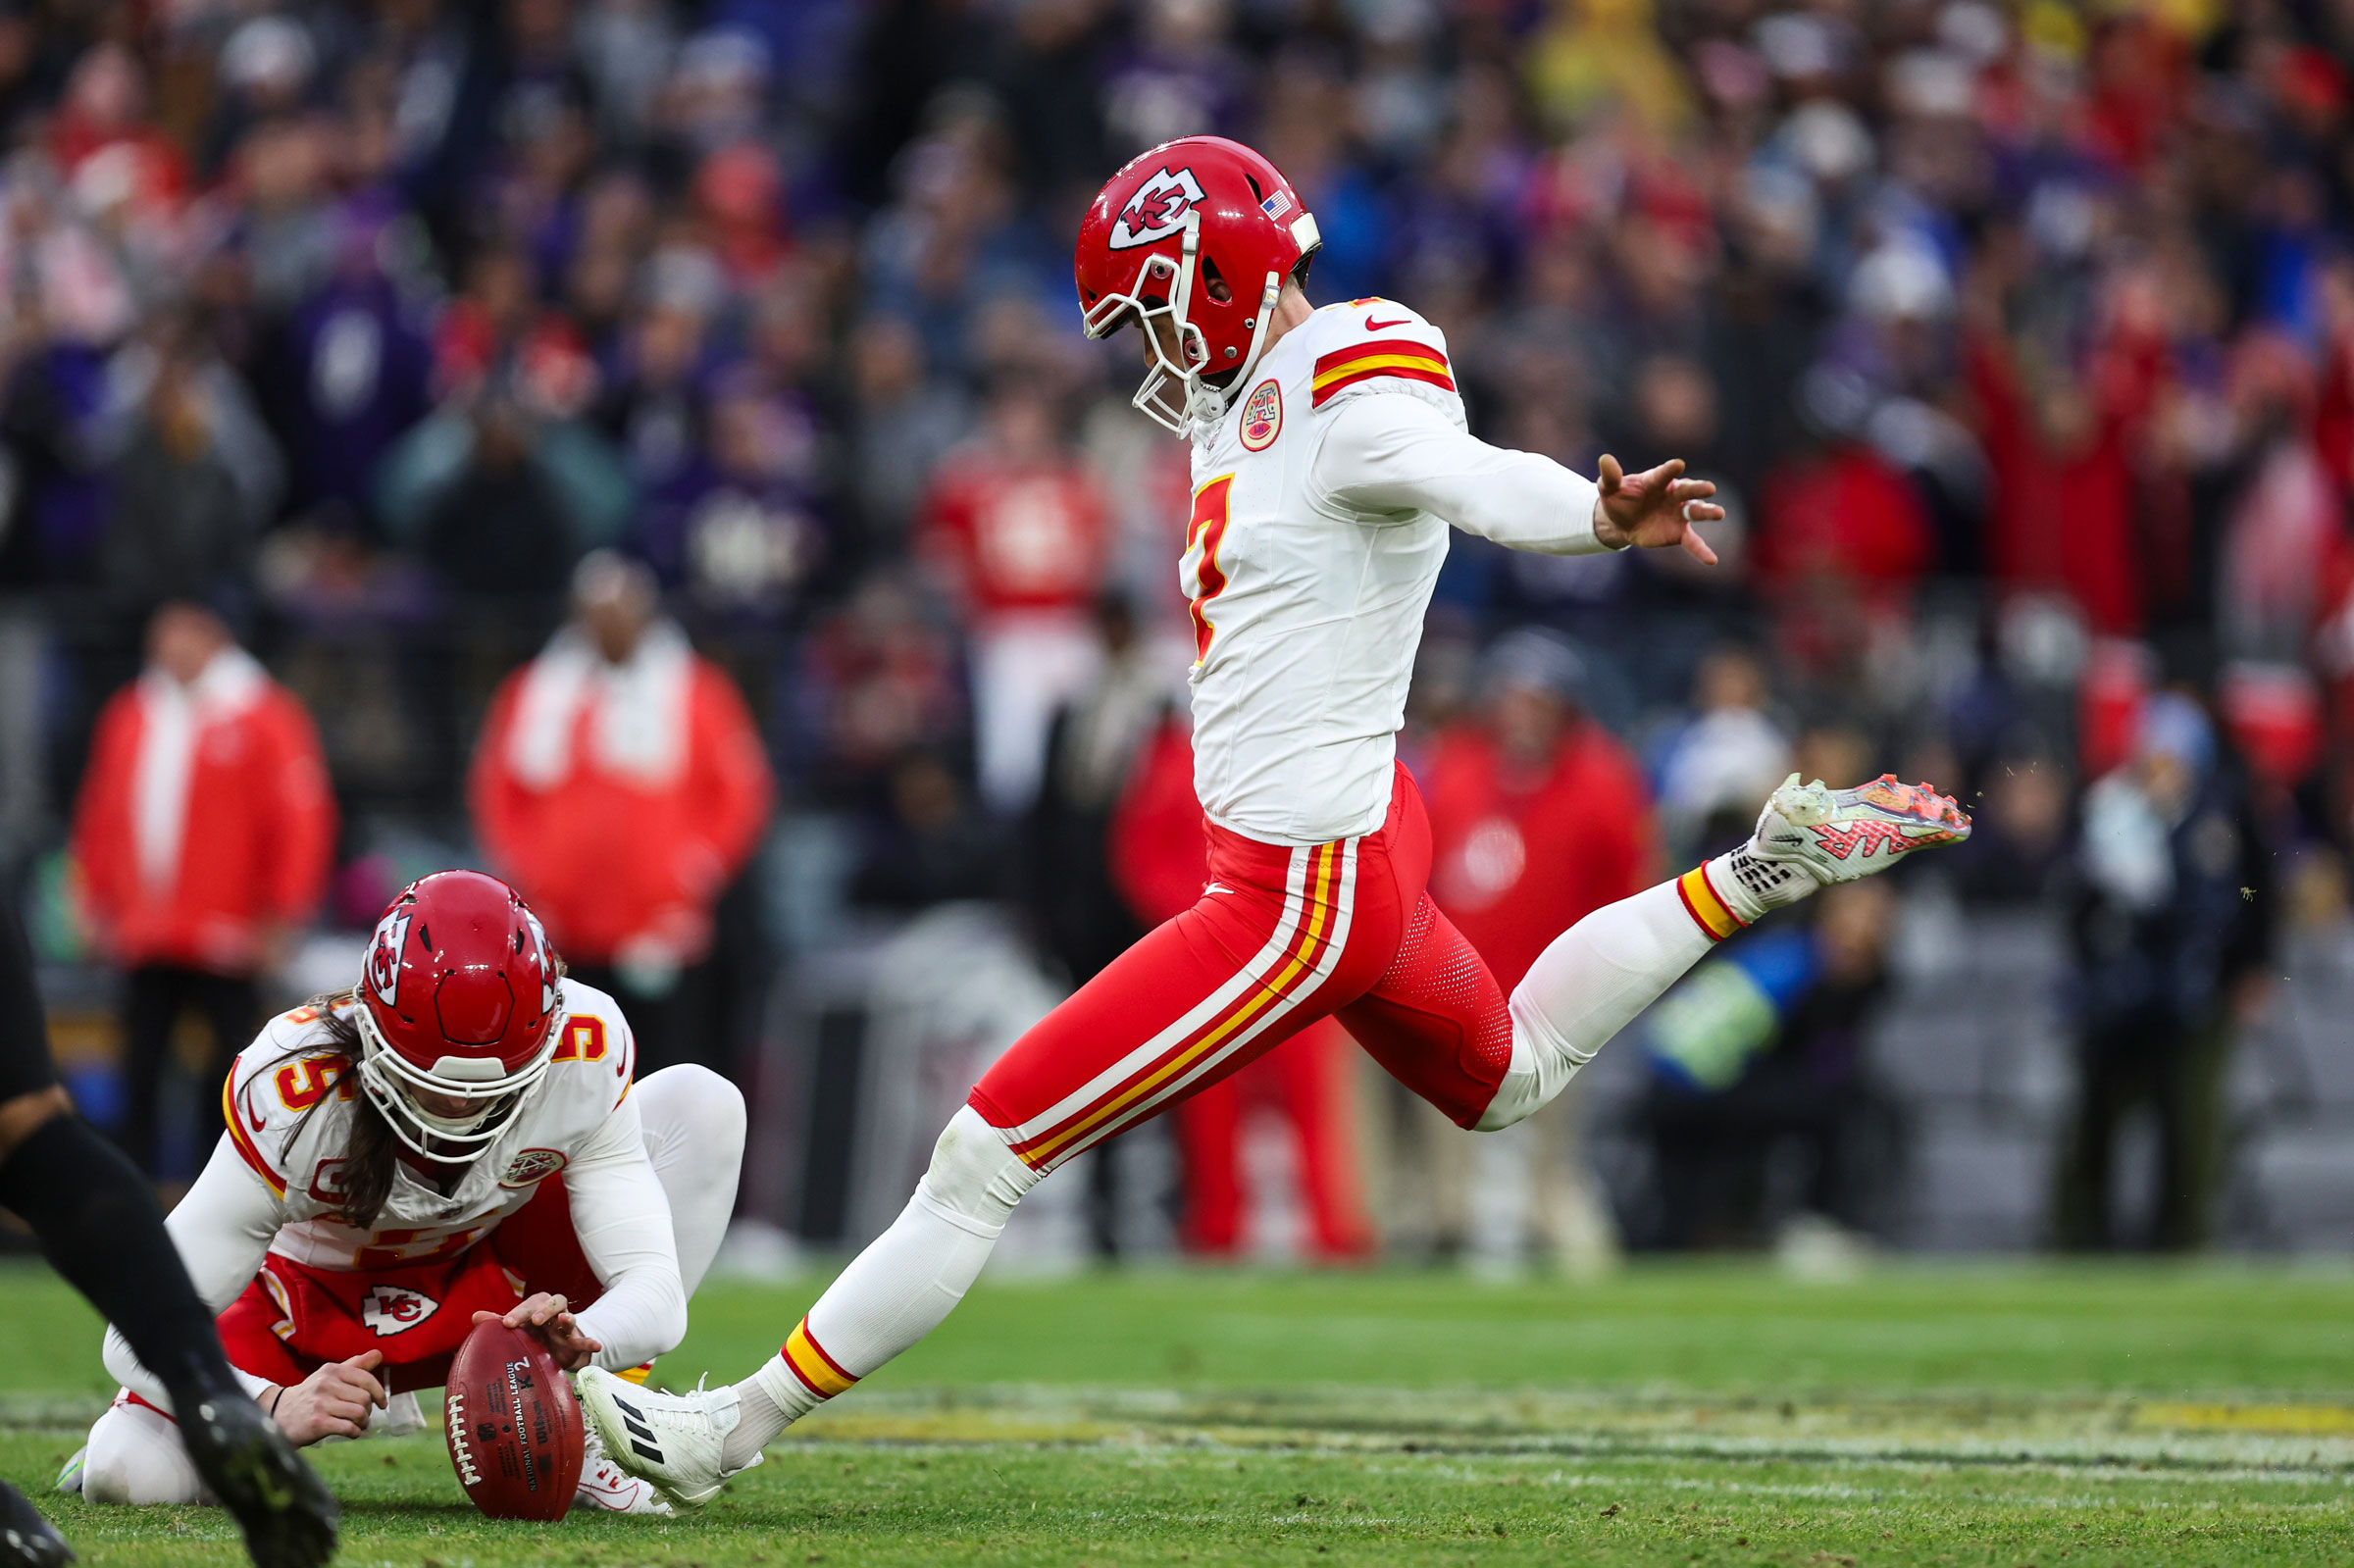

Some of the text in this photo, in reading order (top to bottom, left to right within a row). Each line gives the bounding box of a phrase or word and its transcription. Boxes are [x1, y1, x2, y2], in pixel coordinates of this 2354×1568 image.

[1120, 182, 1191, 239] KC
[1186, 472, 1236, 668] 7
[274, 1053, 356, 1113] 5
[378, 1292, 422, 1322] KC
[506, 1362, 519, 1395] LEAGUE
[514, 1356, 531, 1371] 2
[512, 1398, 528, 1445] FOOTBALL
[522, 1447, 537, 1492] NATIONAL
